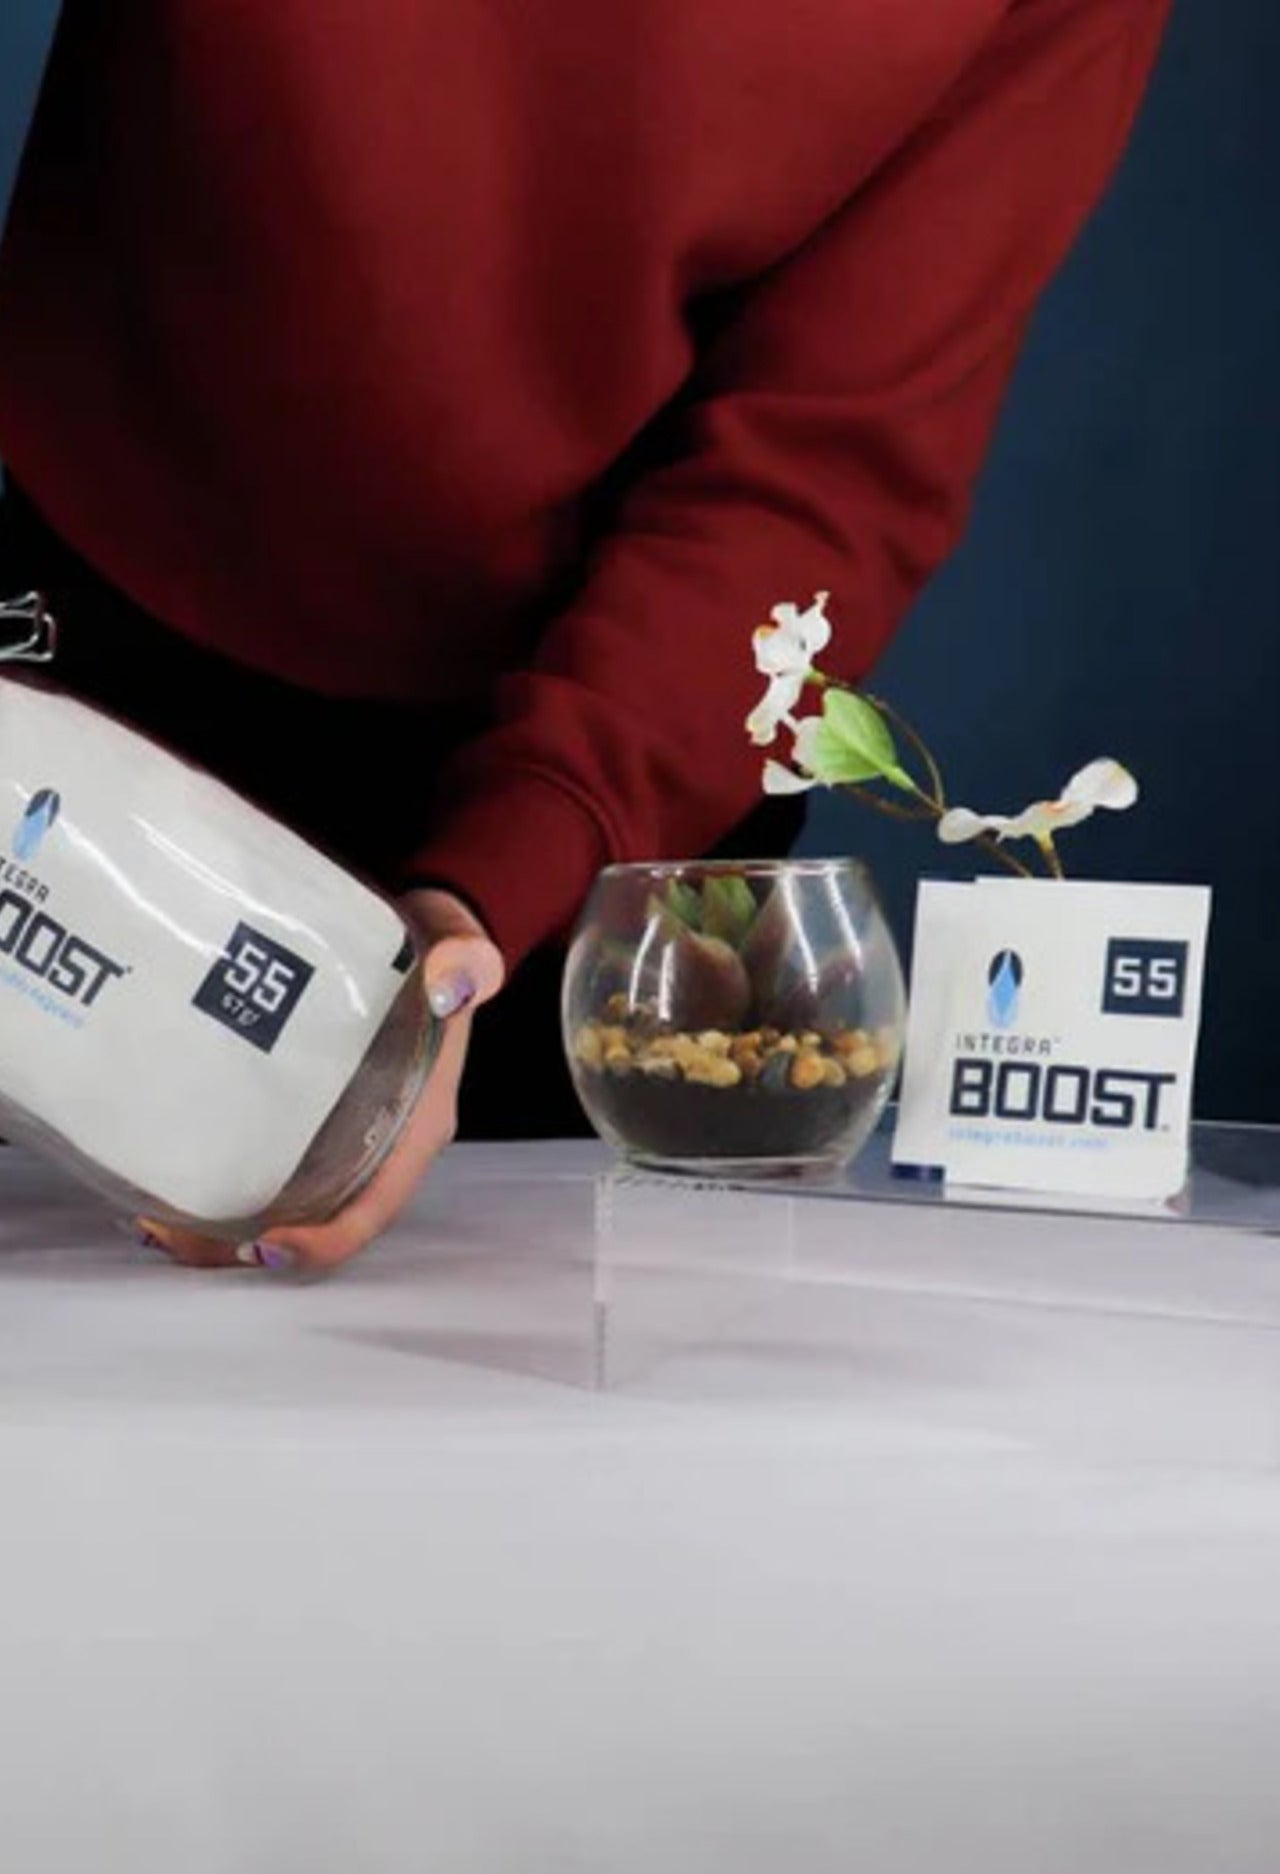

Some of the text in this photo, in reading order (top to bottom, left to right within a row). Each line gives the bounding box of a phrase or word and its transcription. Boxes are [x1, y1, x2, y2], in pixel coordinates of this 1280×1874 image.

[223, 941, 295, 1013] 55
[1112, 957, 1178, 998] 55
[955, 1033, 1054, 1056] INTEGRA
[949, 1057, 1177, 1131] BOOST
